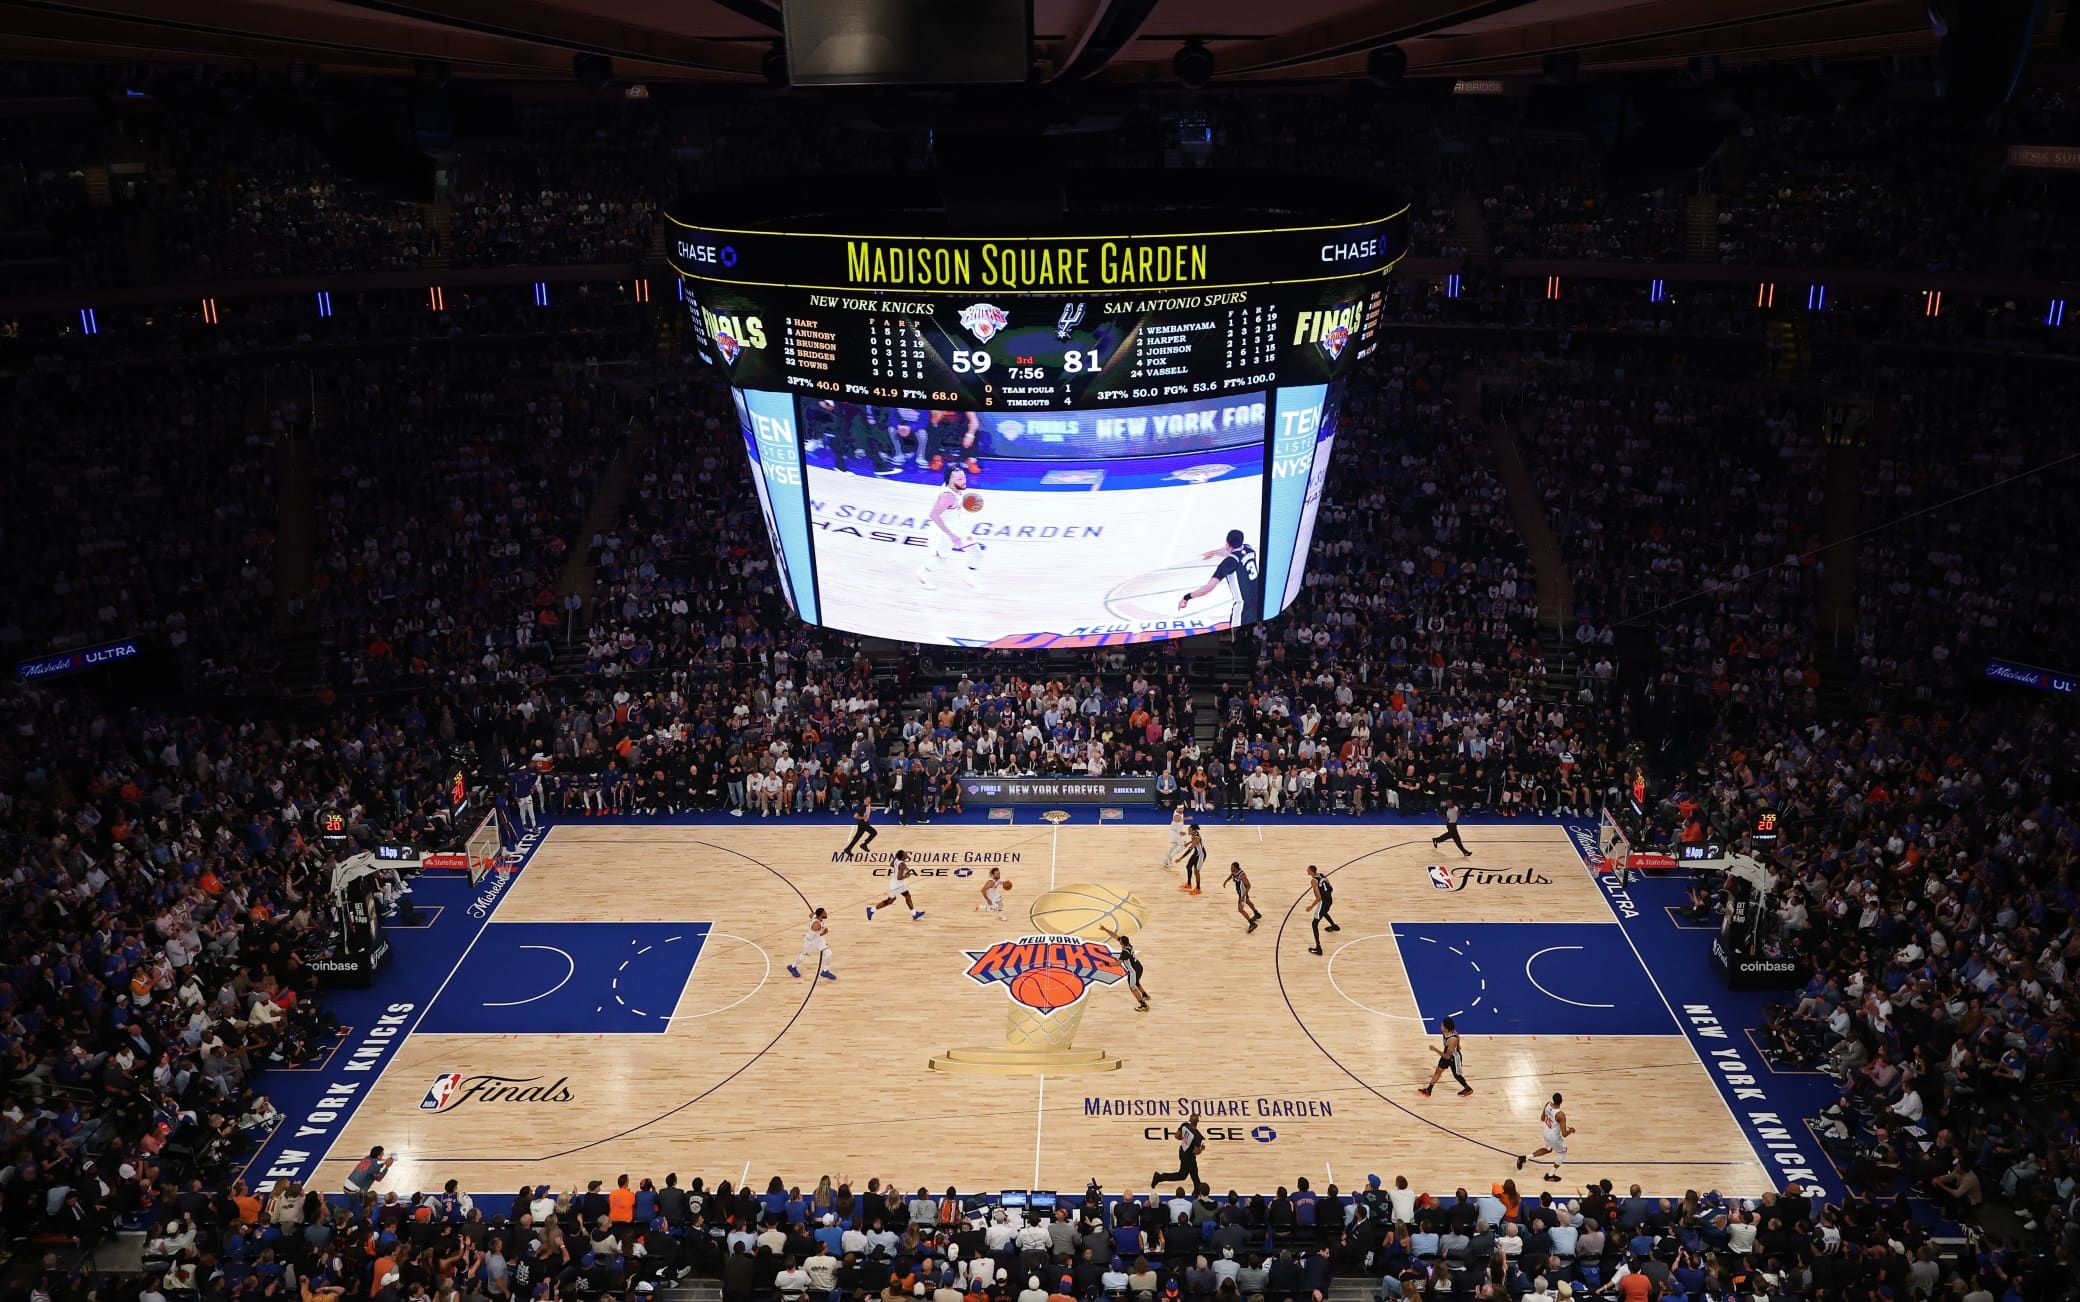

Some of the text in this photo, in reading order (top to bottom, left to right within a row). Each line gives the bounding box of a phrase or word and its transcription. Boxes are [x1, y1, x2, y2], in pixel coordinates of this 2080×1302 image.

[678, 241, 716, 263] CHASE
[1321, 239, 1377, 262] CHASE
[847, 242, 1207, 286] MADISON SQUARE GARDEN
[810, 294, 934, 314] NEW YORK KNICKS
[1104, 291, 1248, 314] SAN ANTONIO SPURS
[793, 318, 818, 328] HART
[884, 328, 891, 336] 5
[1138, 328, 1143, 336] 1
[1147, 322, 1216, 335] WEMBANYAMA
[1267, 313, 1278, 321] 19
[1293, 300, 1364, 346] FINALS
[794, 330, 836, 340] ANUNOBY
[885, 338, 892, 346] 0
[913, 340, 924, 348] 19
[1136, 324, 1277, 346] 2 HARPER 2 3 2 15
[1136, 334, 1274, 357] 3 JOHNSON 2 1 3 2
[784, 338, 794, 346] 11
[796, 339, 836, 350] BRUNSON
[872, 348, 878, 356] 0
[900, 350, 907, 358] 2
[797, 349, 836, 360] BRIDGES
[872, 358, 878, 366] 0
[902, 360, 908, 368] 2
[1136, 344, 1276, 367] 4 FOX 2 6 1 15
[786, 358, 796, 366] 32
[798, 360, 828, 370] TOWNS
[872, 368, 879, 376] 3
[888, 370, 894, 378] 0
[952, 350, 992, 374] 59
[1016, 356, 1034, 364] 3rd
[1064, 349, 1102, 373] 81
[1130, 370, 1143, 378] 24
[1146, 366, 1188, 377] VASSELL
[1240, 358, 1246, 366] 3
[1254, 356, 1260, 364] 3
[1265, 354, 1276, 362] 15
[1008, 367, 1045, 380] 7:56
[787, 376, 958, 401] 3PT% 40.0 FG% 41.9 FT% 68.0
[984, 384, 1072, 394] 0 TEAM FOULS 1
[1097, 372, 1276, 401] 3PT% 50.0 FG% 53.6 FT% 100.0
[986, 398, 993, 406] 5
[1064, 396, 1072, 406] 4
[1096, 417, 1147, 440] NEW
[1154, 410, 1217, 438] YORK
[972, 522, 1104, 538] GARDEN
[1140, 620, 1205, 631] YORK
[22, 645, 136, 678] Michelob ULTRA
[1008, 785, 1106, 796] NEW YORK FOREVER
[326, 822, 341, 831] 20
[1758, 821, 1773, 830] 20
[831, 851, 1021, 863] MADISON SQUARE GARDEN
[1448, 866, 1553, 892] Finals
[1602, 876, 1640, 920] ULTRA
[1019, 936, 1082, 945] NEW YORK
[967, 942, 1129, 979] KNICKS
[1740, 960, 1795, 972] coinbase
[295, 1082, 360, 1138] YORK
[344, 1002, 416, 1071] KNICKS
[426, 1075, 575, 1114] Finals
[1682, 1004, 1827, 1198] NEW YORK KNICKS
[1084, 1097, 1333, 1118] MADISON SQUARE GARDEN
[1144, 1128, 1244, 1141] CHSE
